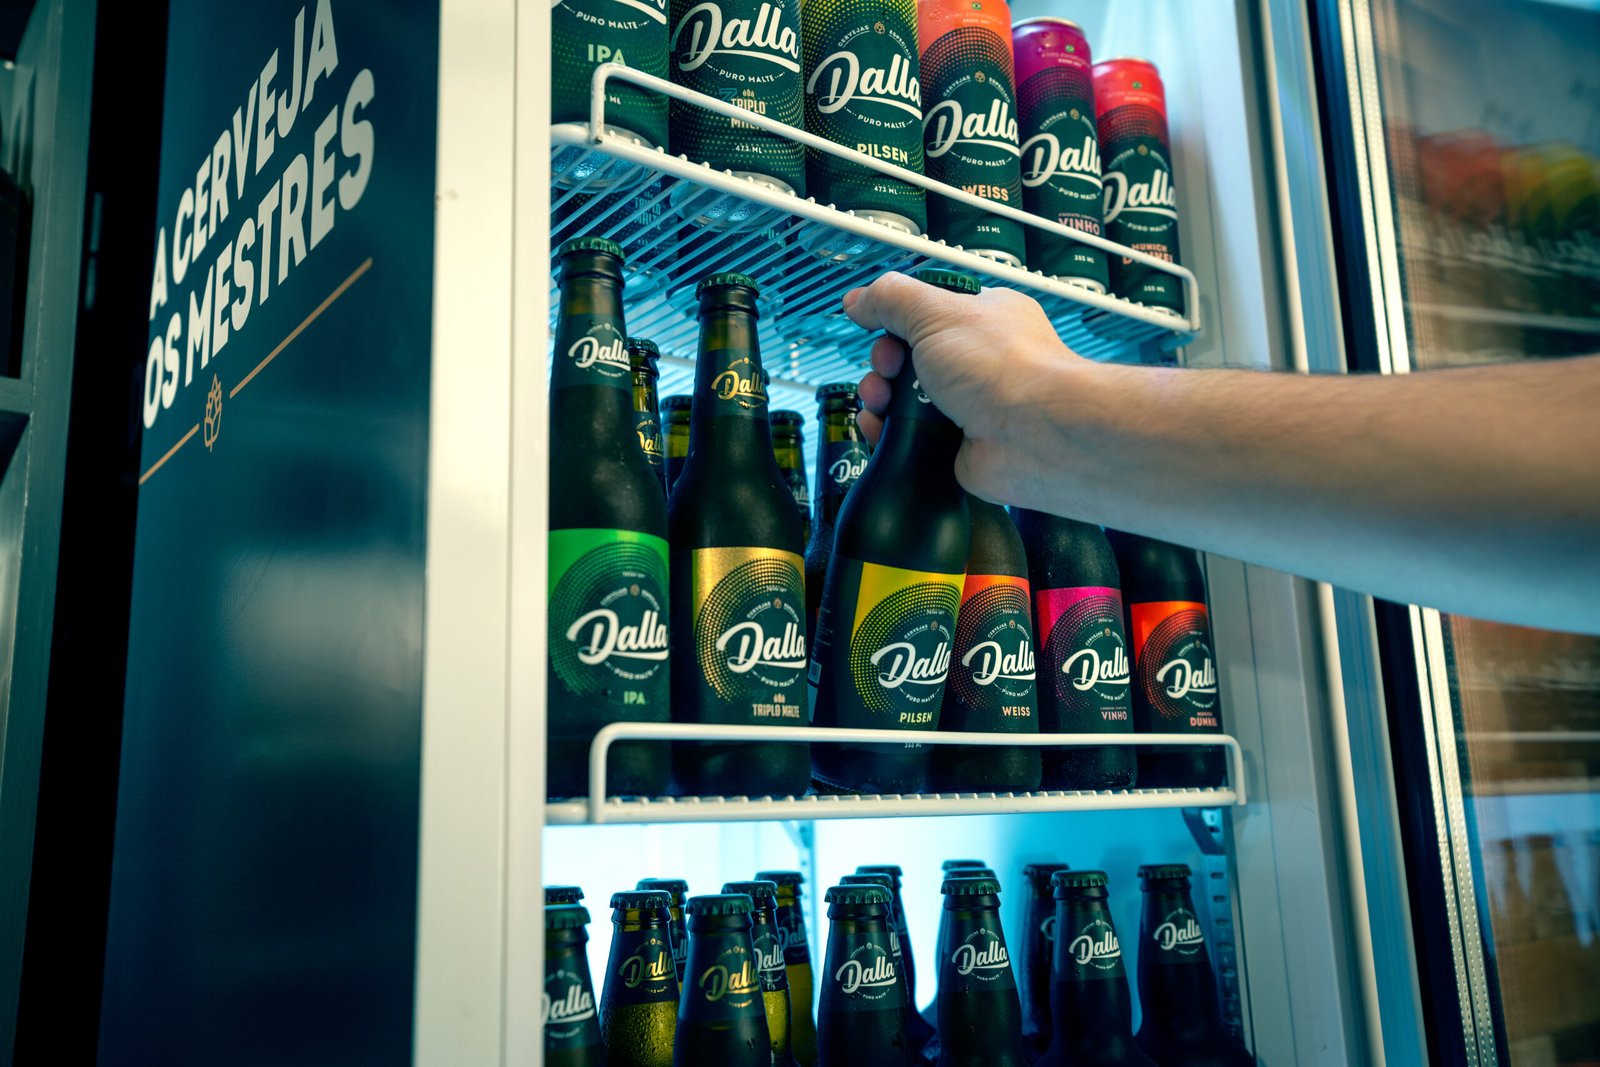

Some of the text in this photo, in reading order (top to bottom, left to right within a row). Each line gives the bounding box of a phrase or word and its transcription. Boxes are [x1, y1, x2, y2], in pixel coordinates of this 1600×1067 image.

[576, 11, 605, 26] PURO
[608, 20, 638, 29] MALTE
[670, 2, 800, 73] Dalla
[837, 25, 870, 47] CERVEJAS
[587, 43, 626, 66] IPA
[719, 69, 774, 83] PURO MALTE
[806, 51, 922, 120] Dalla
[857, 115, 906, 129] PURO MALTE
[922, 100, 1020, 158] Dalla
[149, 0, 339, 320] A CERVEJA
[752, 146, 762, 154] ML
[857, 143, 909, 165] PILSEN
[961, 156, 1006, 167] PURO MALTE
[888, 187, 898, 195] ML
[961, 185, 1009, 201] WEISS
[1058, 218, 1100, 235] VINHO
[143, 68, 375, 429] OS MESTRES
[568, 336, 631, 371] Dalla
[566, 609, 669, 665] Dalla
[716, 621, 807, 673] Dalla
[623, 691, 646, 704] IPA
[752, 704, 780, 717] TRIPLO
[900, 711, 933, 723] PILSEN
[1002, 706, 1031, 716] WEISS
[1101, 711, 1128, 720] VINHO
[951, 941, 1009, 975] Dalla
[1069, 931, 1121, 965] Dalla
[835, 956, 897, 994] Dalla
